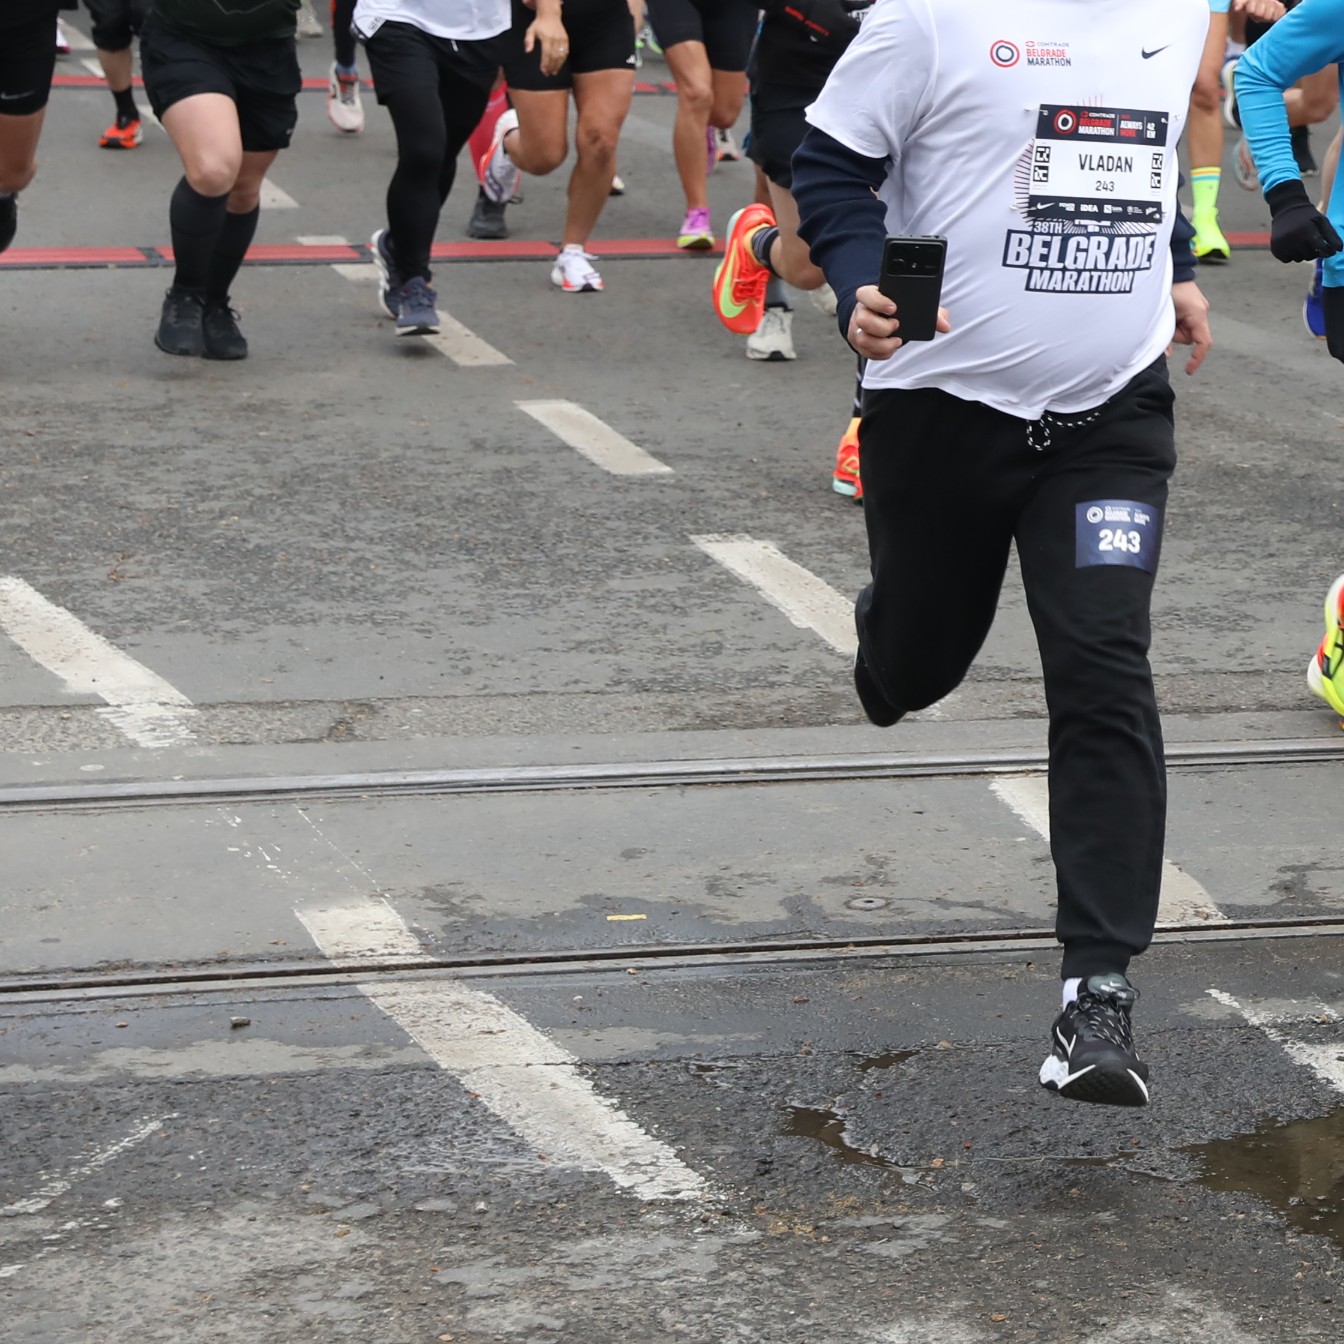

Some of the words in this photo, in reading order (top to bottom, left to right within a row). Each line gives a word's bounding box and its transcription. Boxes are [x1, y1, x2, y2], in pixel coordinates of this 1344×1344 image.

[1026, 48, 1067, 58] BELGRADE
[1027, 57, 1072, 67] MARATHON
[1078, 126, 1115, 137] MARATHON
[1078, 153, 1134, 174] VLADAN
[1094, 180, 1116, 193] 243
[1033, 220, 1064, 234] 38TH
[1005, 231, 1157, 270] BELGRADE
[1029, 268, 1135, 292] MARATHON
[1097, 528, 1142, 554] 243
